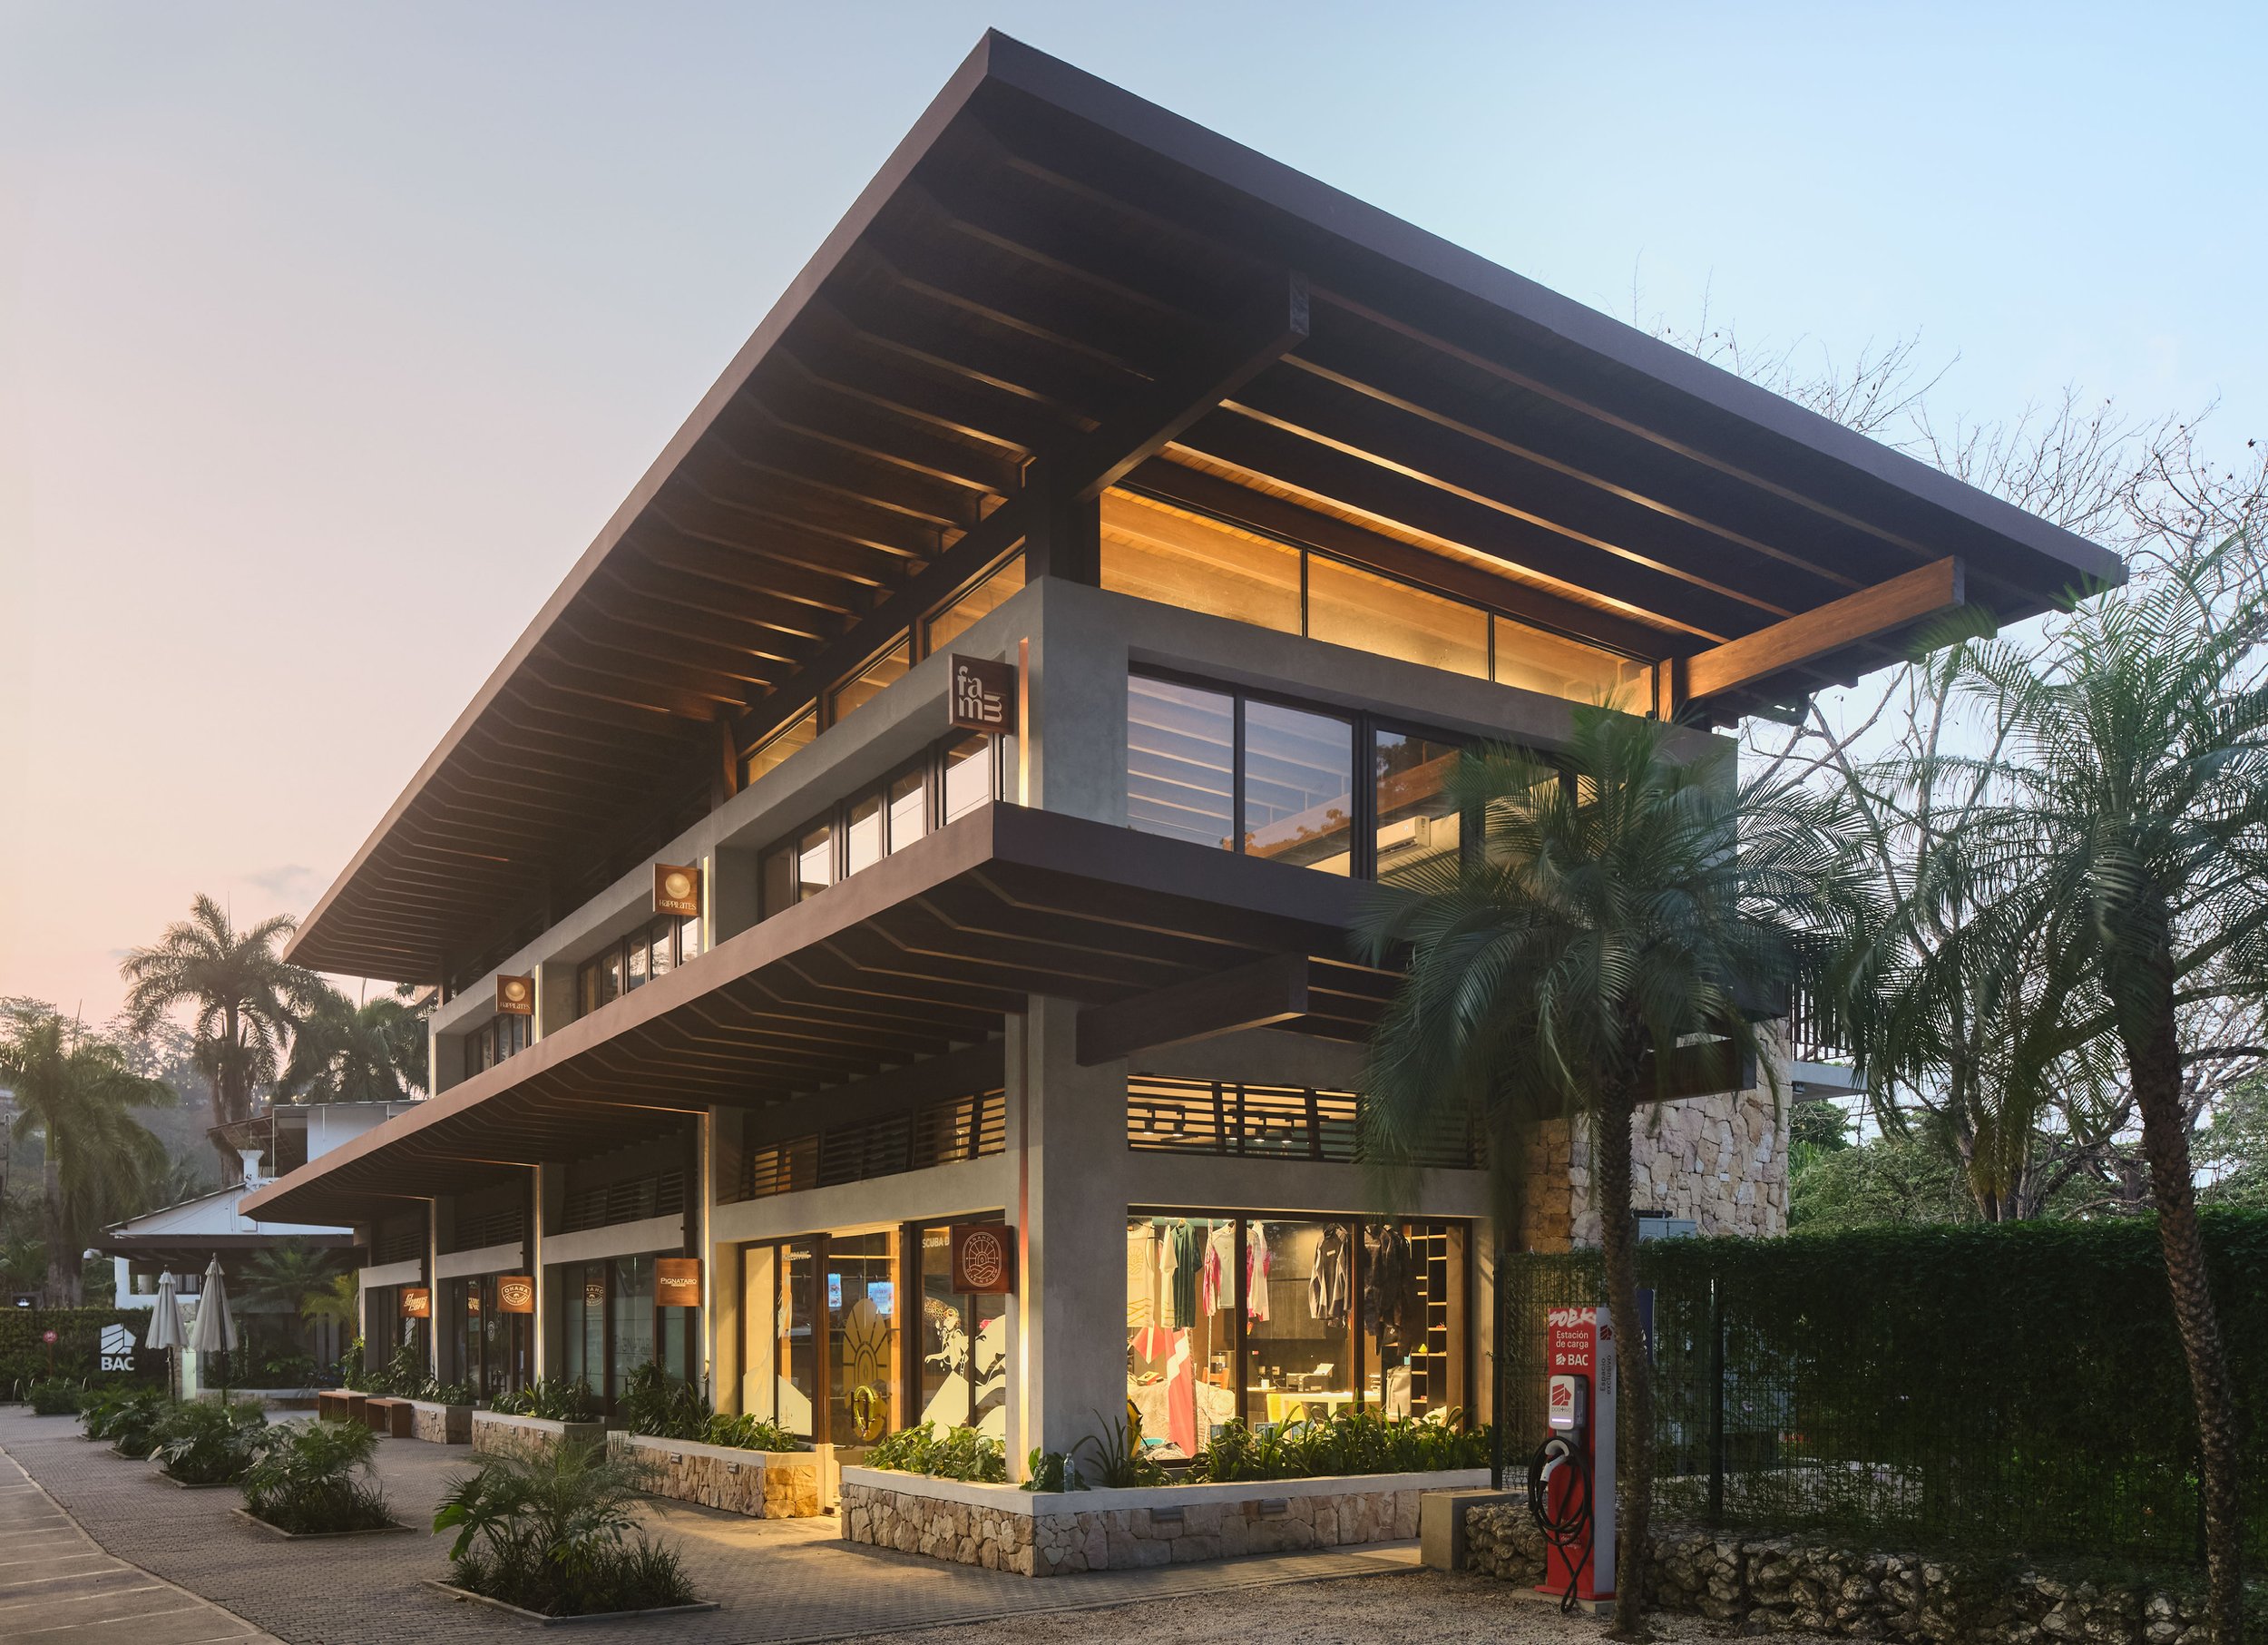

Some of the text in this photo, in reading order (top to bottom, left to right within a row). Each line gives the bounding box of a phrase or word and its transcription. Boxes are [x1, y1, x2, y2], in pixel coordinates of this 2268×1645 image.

[922, 1237, 943, 1248] SCUBA
[969, 1235, 994, 1246] ANANDA
[660, 1277, 698, 1285] PIGNATARO
[503, 1286, 529, 1294] OHANA
[1556, 1329, 1589, 1339] Estación
[1556, 1339, 1589, 1350] de carga
[101, 1356, 135, 1371] BAC
[1568, 1354, 1589, 1366] BAC
